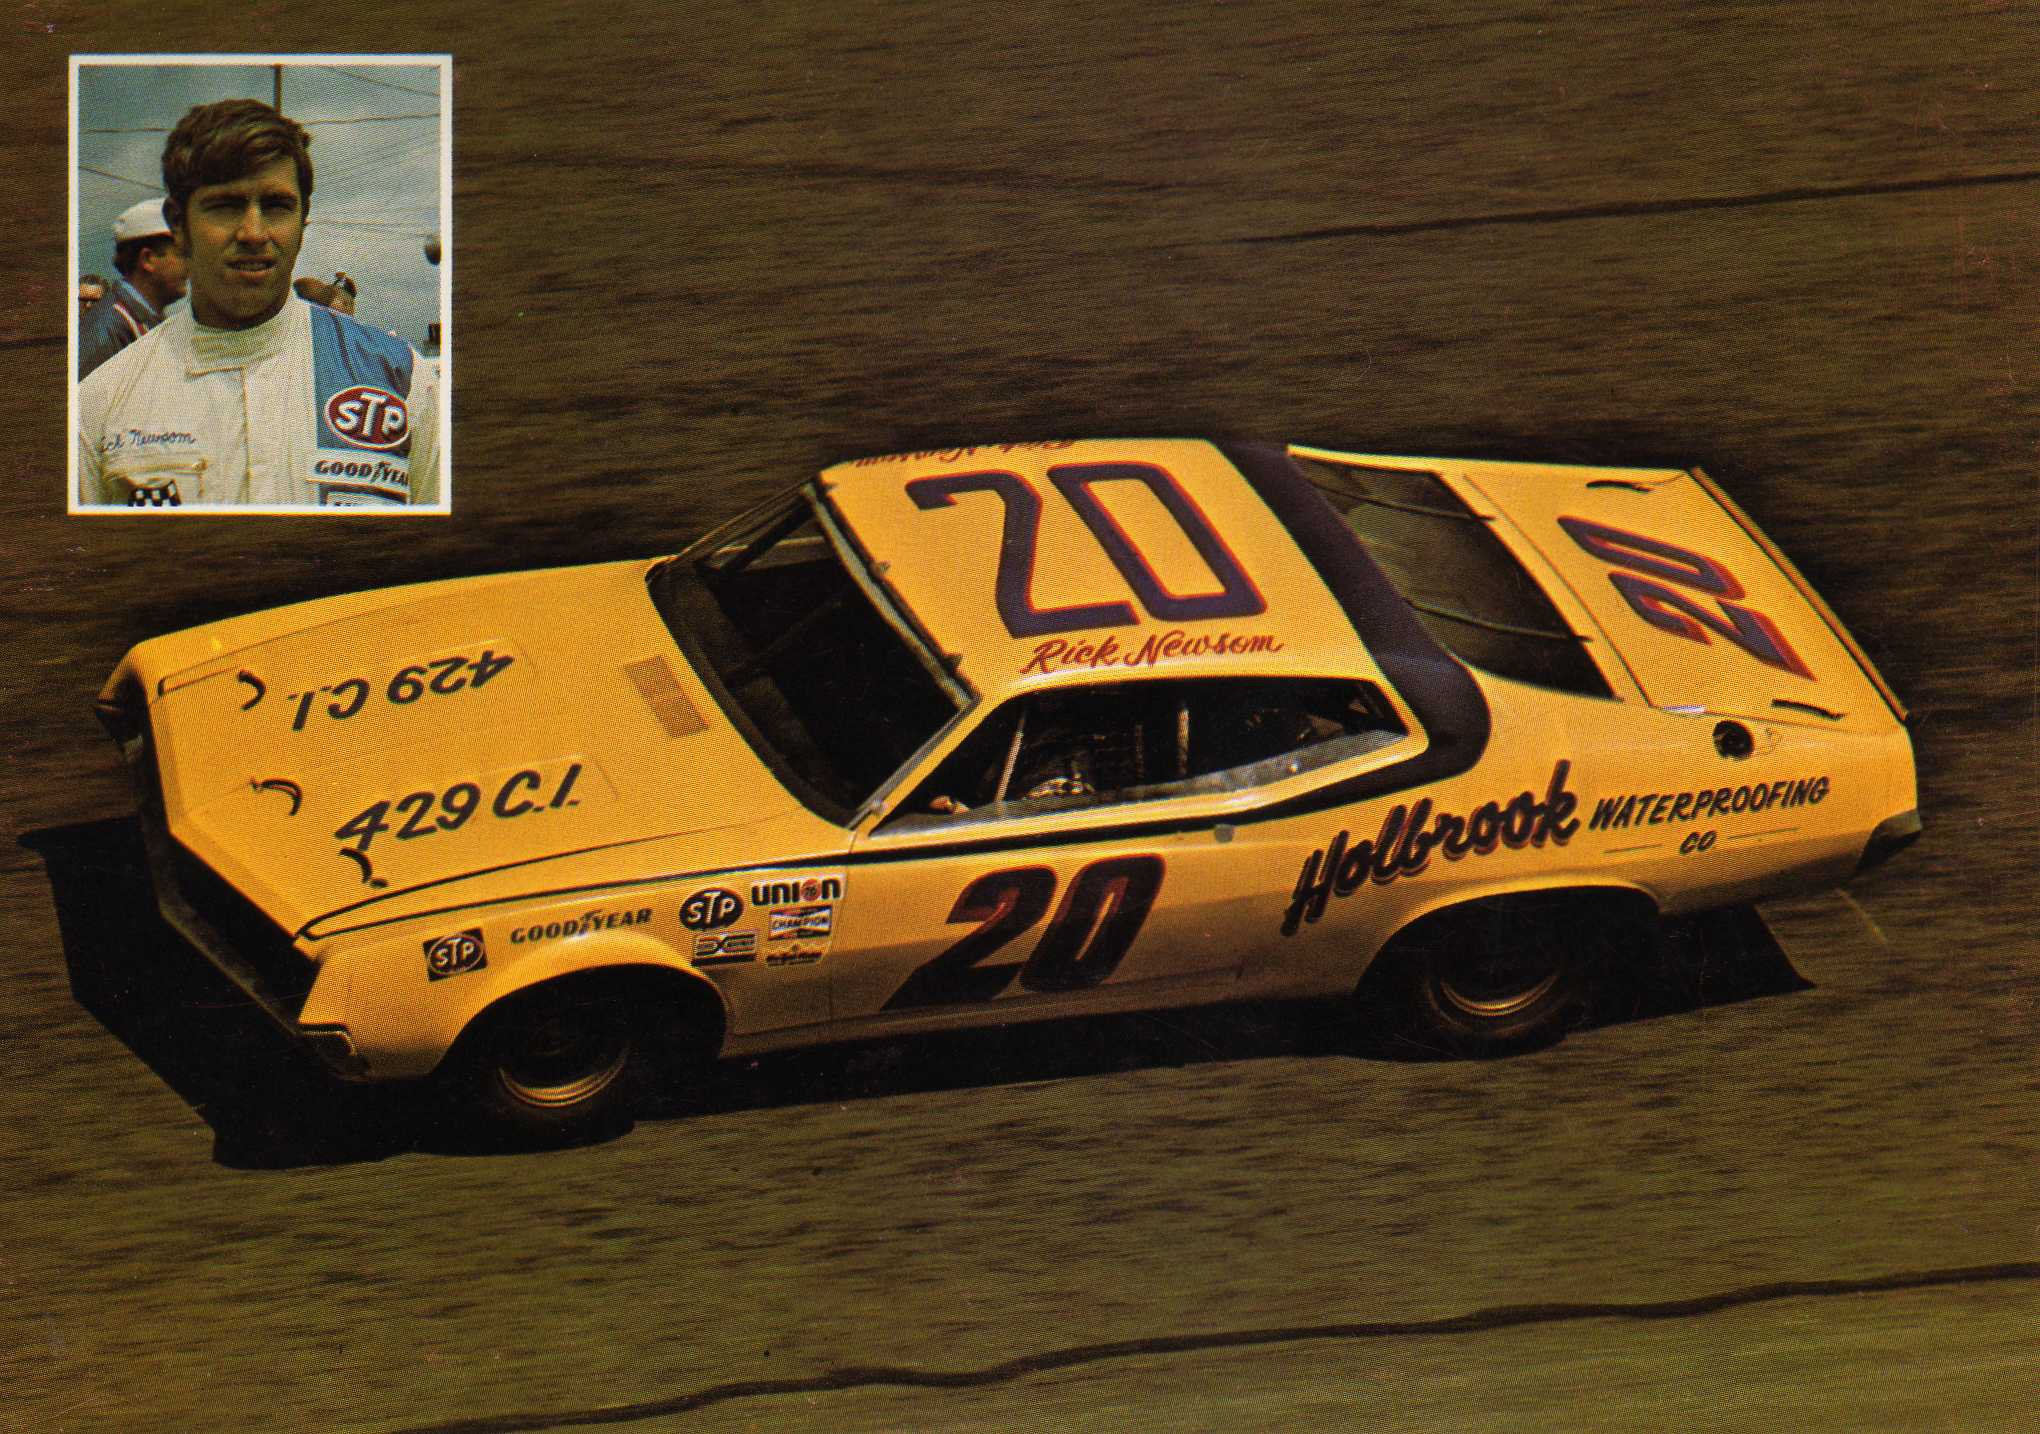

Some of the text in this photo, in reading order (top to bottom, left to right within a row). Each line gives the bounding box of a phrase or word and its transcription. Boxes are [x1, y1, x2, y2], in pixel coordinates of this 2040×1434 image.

[335, 391, 406, 437] STP
[315, 459, 409, 487] GOODYEA
[905, 461, 1268, 640] 20
[1557, 515, 1818, 682] 20
[387, 650, 515, 705] 429
[1020, 630, 1285, 675] Rick Newsom
[334, 782, 481, 852] 429
[1589, 776, 1830, 831] WATERPROOFING
[1280, 759, 1581, 936] Holbrook
[1679, 830, 1717, 855] CO
[510, 908, 653, 945] GOODYEAR
[686, 890, 736, 926] STP
[879, 853, 1167, 1013] 20
